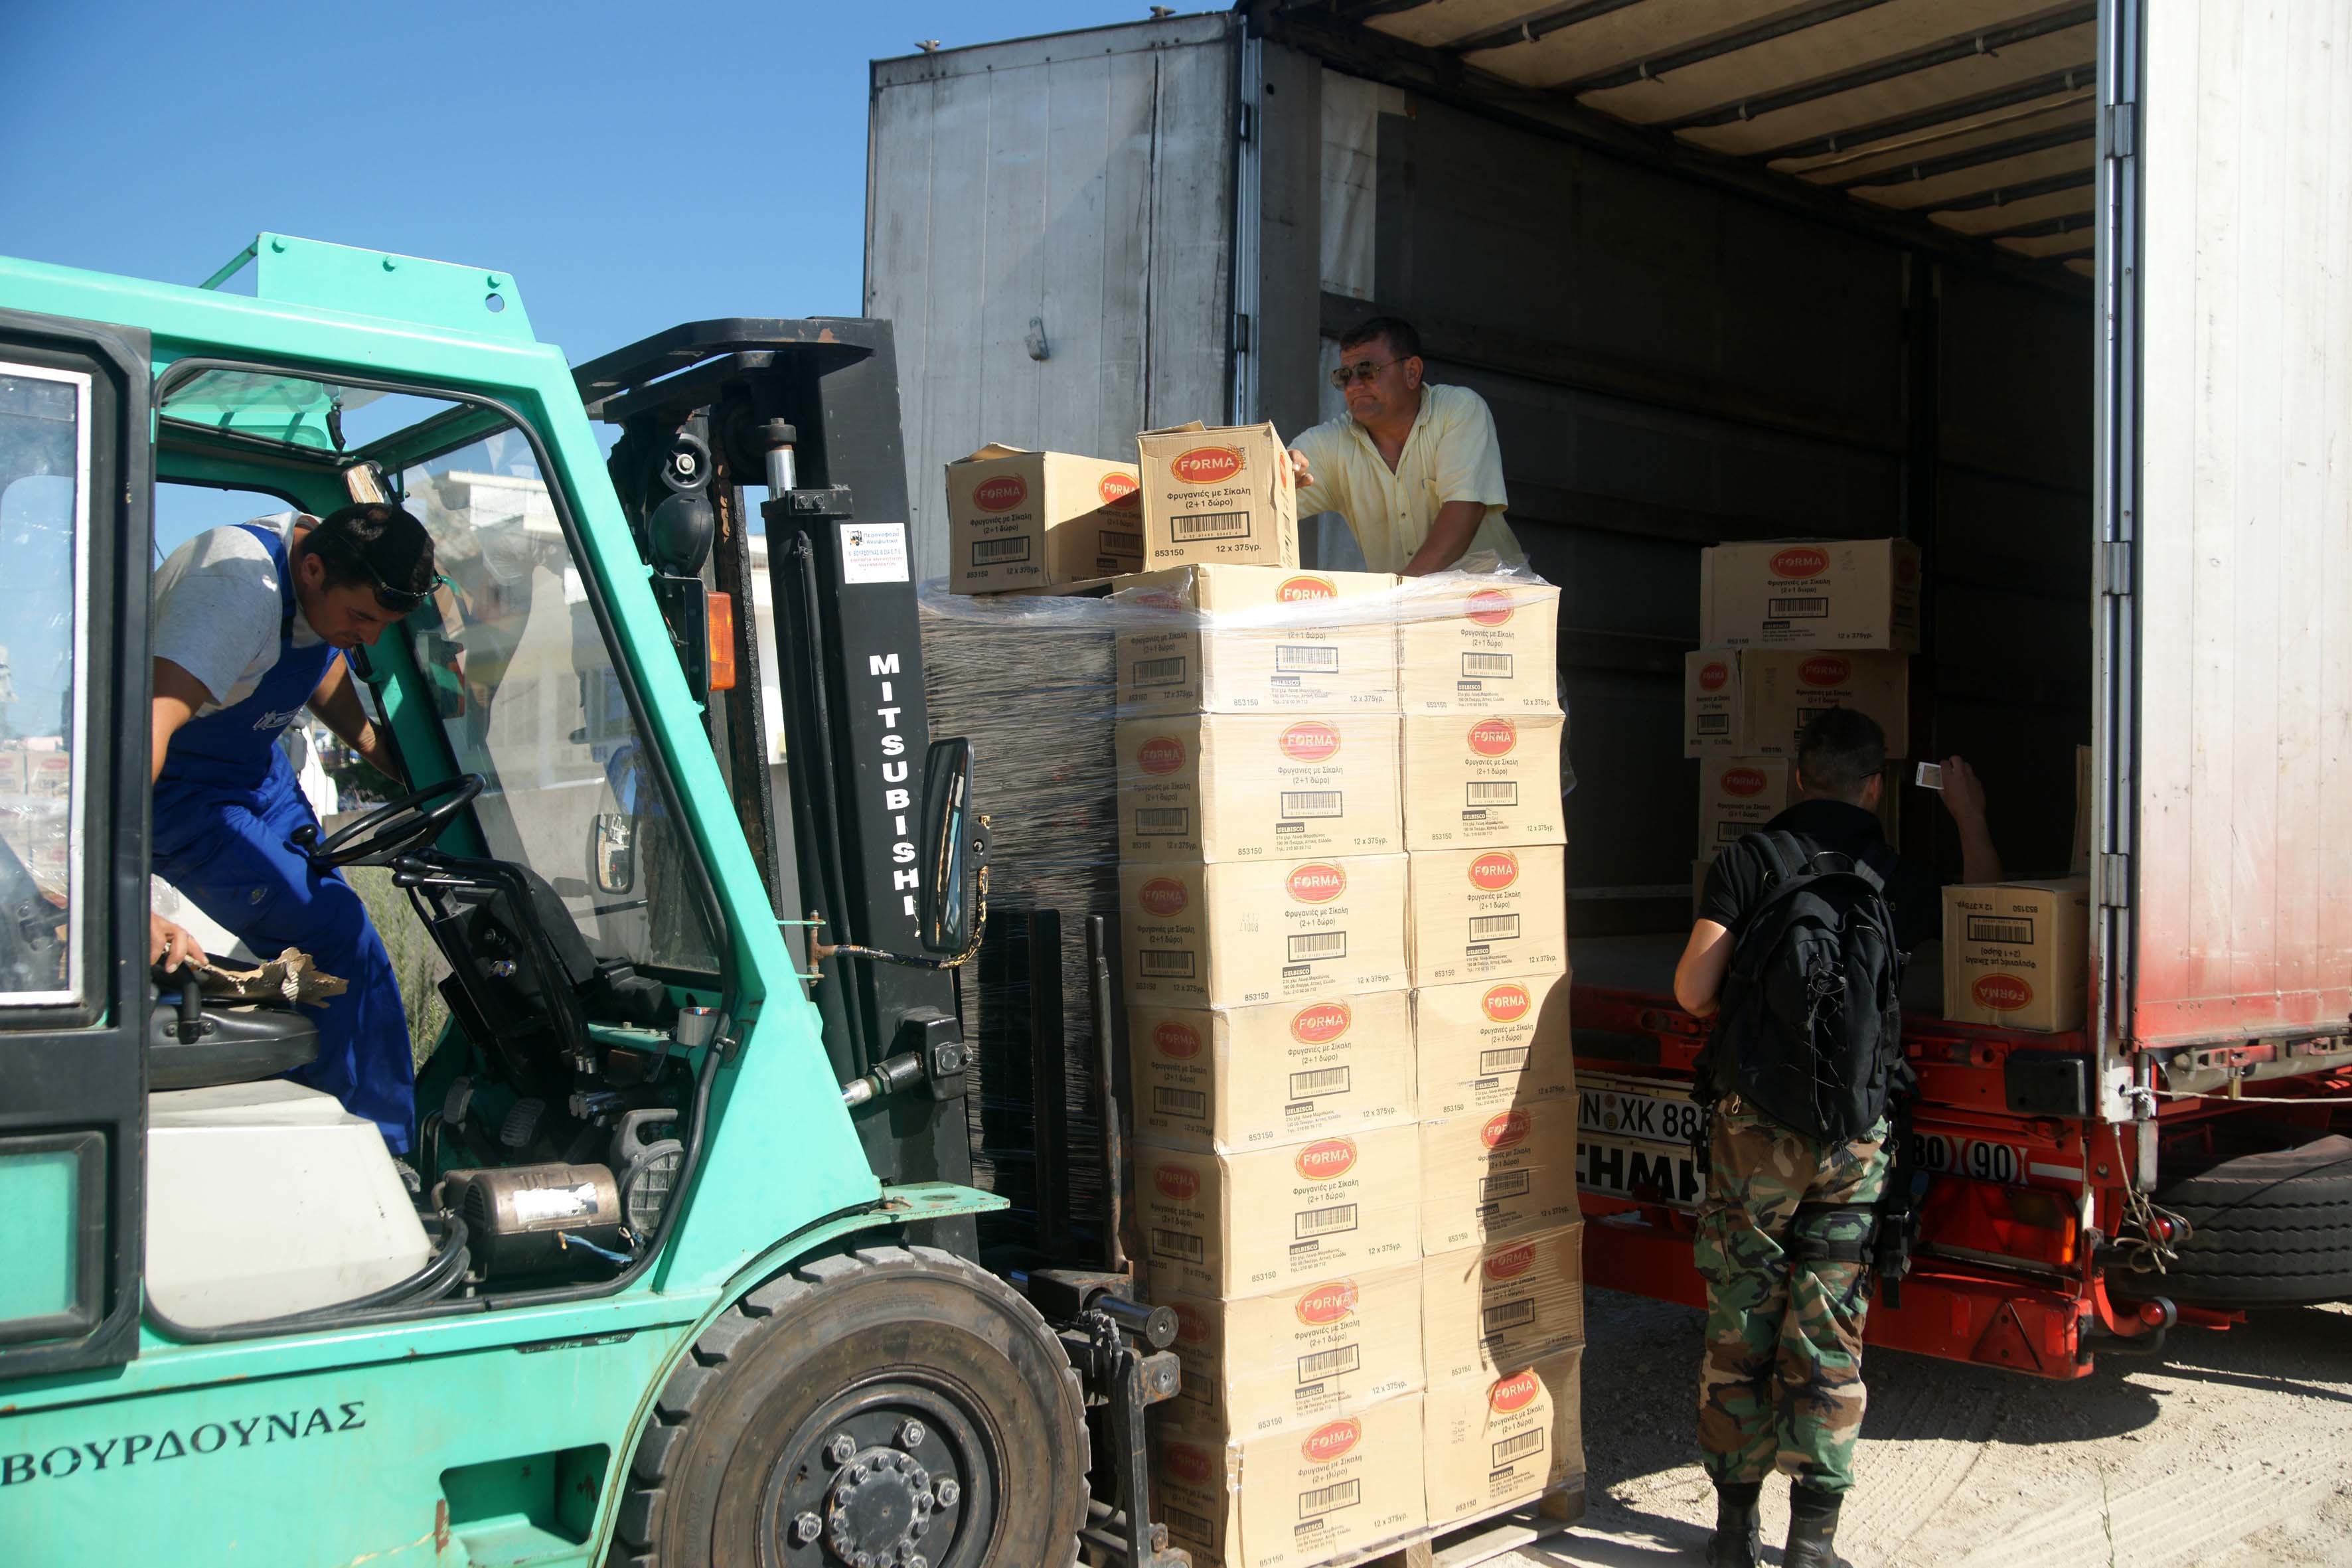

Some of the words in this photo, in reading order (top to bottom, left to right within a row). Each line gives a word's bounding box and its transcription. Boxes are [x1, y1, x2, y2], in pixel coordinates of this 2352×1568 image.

[1180, 457, 1235, 472] FORMA
[980, 486, 1020, 499] FORMA
[1778, 557, 1822, 567] FORMA
[1285, 588, 1330, 601] FORMA
[1288, 734, 1333, 746] FORMA
[1474, 732, 1511, 742] FORMA
[1142, 749, 1180, 761] FORMA
[869, 653, 919, 916] MITSUBISHI
[1727, 776, 1761, 787] FORMA
[1238, 847, 1262, 856] 853150
[1476, 864, 1512, 876] FORMA
[1294, 874, 1339, 889] FORMA
[1145, 891, 1182, 902] FORMA
[1435, 969, 1454, 978] 853150
[1245, 992, 1269, 1001] 853150
[1980, 986, 2025, 1000] FORMA
[1488, 995, 1525, 1008] FORMA
[1299, 1014, 1344, 1030] FORMA
[1444, 1103, 1464, 1113] 853150
[1620, 1097, 1656, 1134] XK
[1249, 1131, 1273, 1142] 853150
[1304, 1149, 1350, 1166] FORMA
[1974, 1142, 2011, 1182] 90
[1448, 1232, 1468, 1243] 853150
[1252, 1271, 1276, 1282] 853150
[1304, 1294, 1351, 1312] FORMA
[1451, 1365, 1472, 1376] 853150
[1495, 1380, 1533, 1401] FORMA
[1259, 1417, 1282, 1429] 853150
[0, 1400, 367, 1486] ΒΟΥΡΔΟΥΝΑΣ
[1455, 1499, 1476, 1512] 853150
[1259, 1555, 1283, 1567] 853150
